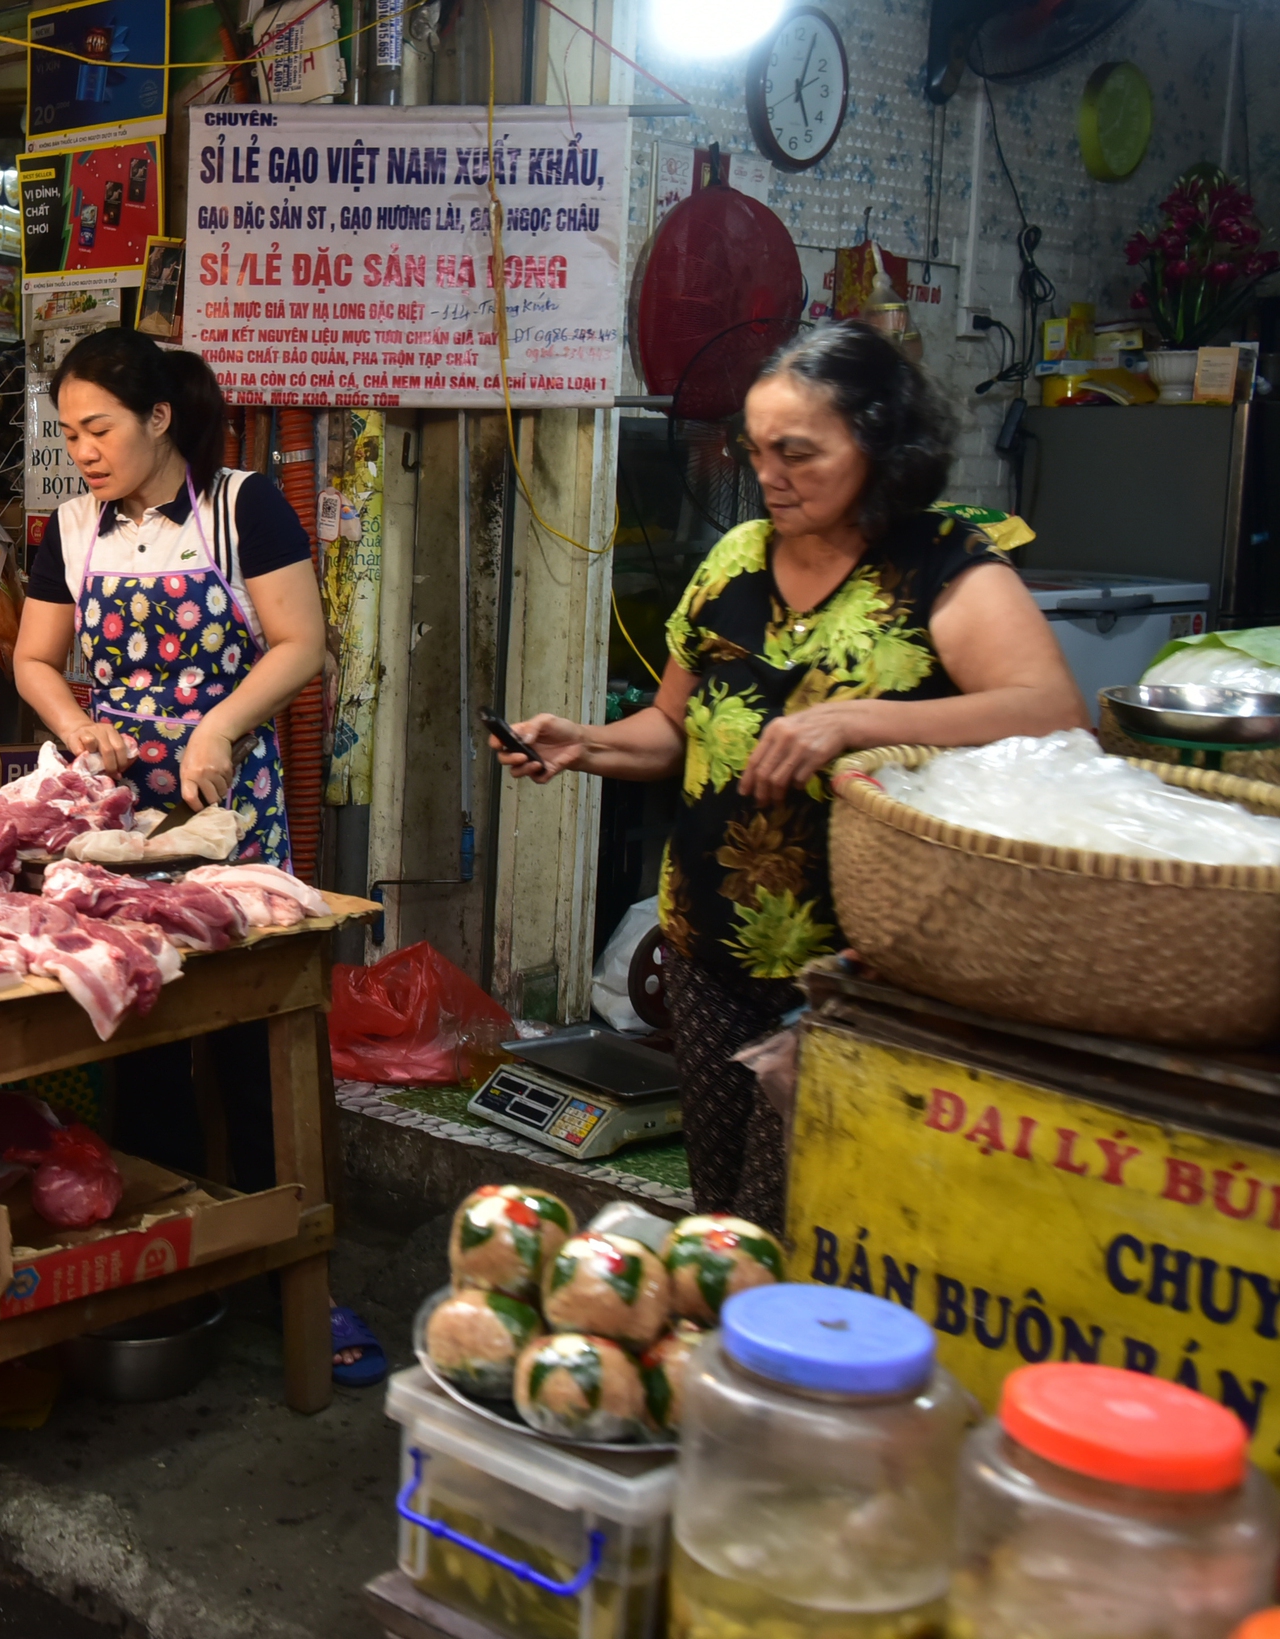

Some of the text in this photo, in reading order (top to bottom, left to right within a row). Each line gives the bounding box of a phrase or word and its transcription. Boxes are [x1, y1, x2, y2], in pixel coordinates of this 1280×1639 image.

[35, 27, 51, 36] NEW
[795, 27, 805, 41] 12
[818, 59, 828, 72] 2
[765, 79, 773, 93] 9
[820, 84, 830, 98] 3
[34, 104, 55, 126] 20
[204, 109, 278, 127] CHUYÊN:
[815, 110, 824, 123] 4
[775, 128, 784, 141] 7
[788, 136, 798, 150] 6
[804, 130, 813, 143] 5
[200, 132, 605, 192] SỈ LẺ GẠO VIỆT NAM XUẤT KHẨU,
[35, 171, 53, 179] SELLER
[24, 185, 61, 202] VỊ ĐỈNH,
[25, 202, 50, 218] CHẤT
[198, 205, 229, 235] GẠO
[233, 201, 265, 235] ĐẶC
[270, 197, 302, 230] SẢN
[340, 206, 372, 235] GẠO
[376, 204, 431, 231] HƯƠNG
[435, 202, 465, 234] LÀI,
[470, 207, 493, 237] GẠ
[506, 207, 552, 237] NGỌC
[556, 203, 600, 232] CHÂU
[26, 223, 49, 235] CHƠI
[199, 241, 231, 286] SỈ
[291, 246, 353, 294] ĐẶC
[363, 243, 426, 288] SẢN
[435, 254, 476, 296] HẠ
[205, 297, 425, 323] CHẢ MỰC GIÃ TAY HẠ LONG ĐẶC BIỆT
[200, 325, 499, 346] CAM KẾT NGUYÊN LIỆU MỰC TƯƠI CHUẨN GIÃ TAY
[201, 346, 479, 369] KHÔNG CHẤT BẢO QUẢN, PHA TRỘN TẠP CHẤT
[217, 370, 606, 393] OÀI RA CÒN CÓ CHẢ CÁ, CHẢ NEM HẢI SẢN, CÁ CHỈ VÀNG LOẠI 1
[271, 390, 400, 406] MỰC KHÔ, RUỐC TÔM
[42, 420, 63, 438] RU
[31, 446, 62, 471] BỘT
[42, 474, 74, 499] BỘT
[924, 1087, 1038, 1160] ĐẠI
[1054, 1129, 1142, 1187] LÝ
[811, 1225, 919, 1310] BÁN
[934, 1273, 1104, 1366] BUÔN
[1106, 1233, 1280, 1341] CHUY
